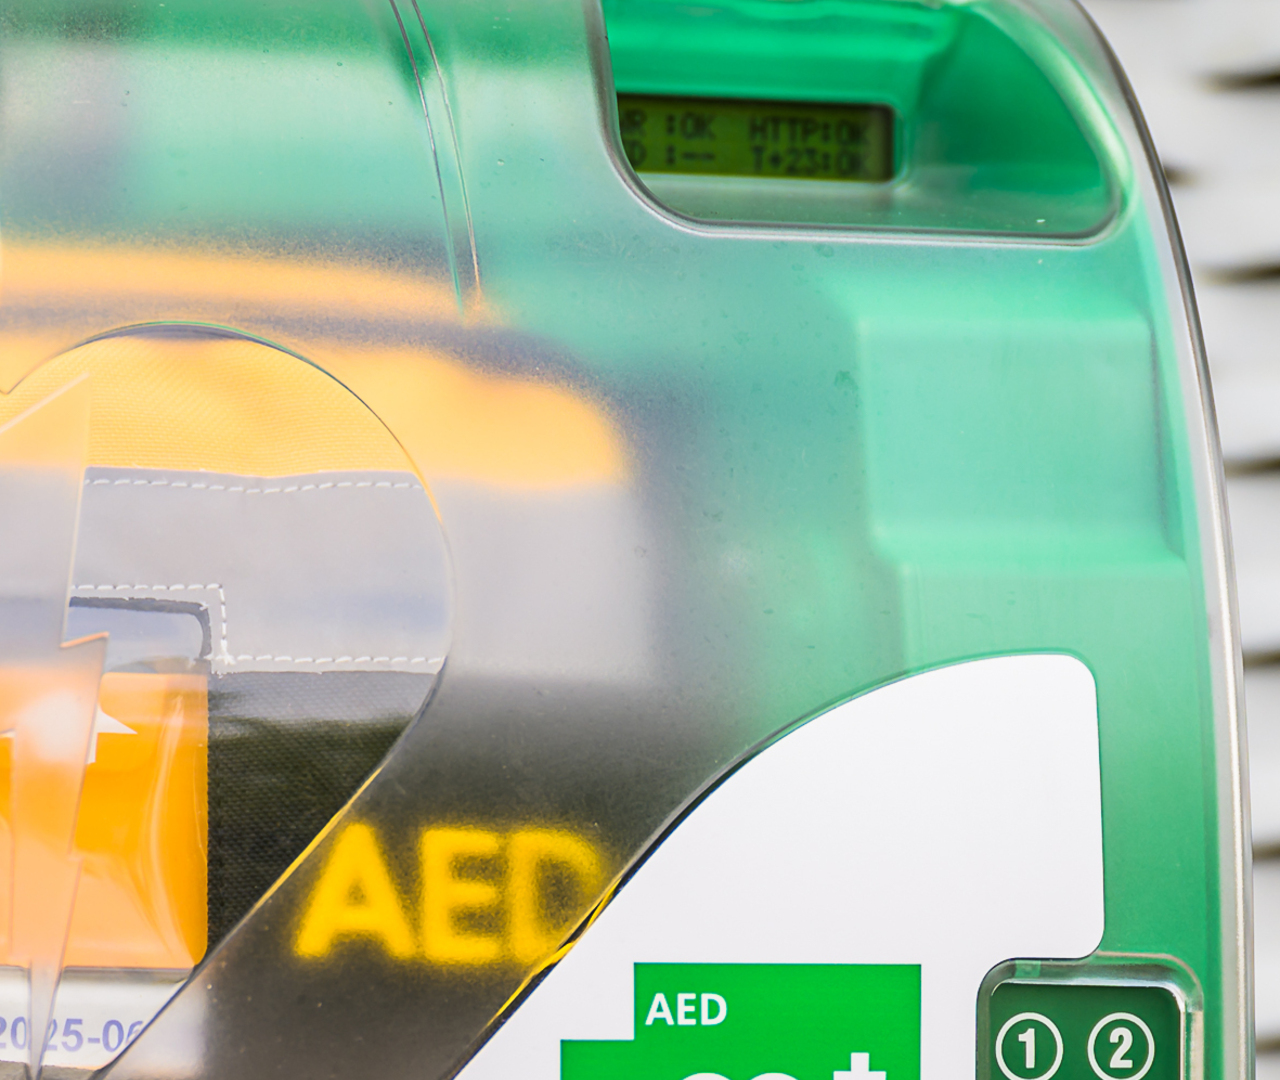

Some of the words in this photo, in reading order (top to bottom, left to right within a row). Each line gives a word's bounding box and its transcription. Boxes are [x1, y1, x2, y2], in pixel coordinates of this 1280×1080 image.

[294, 822, 604, 964] AED
[645, 992, 728, 1026] AED
[1017, 1027, 1036, 1069] 1
[1109, 1026, 1134, 1069] 2
